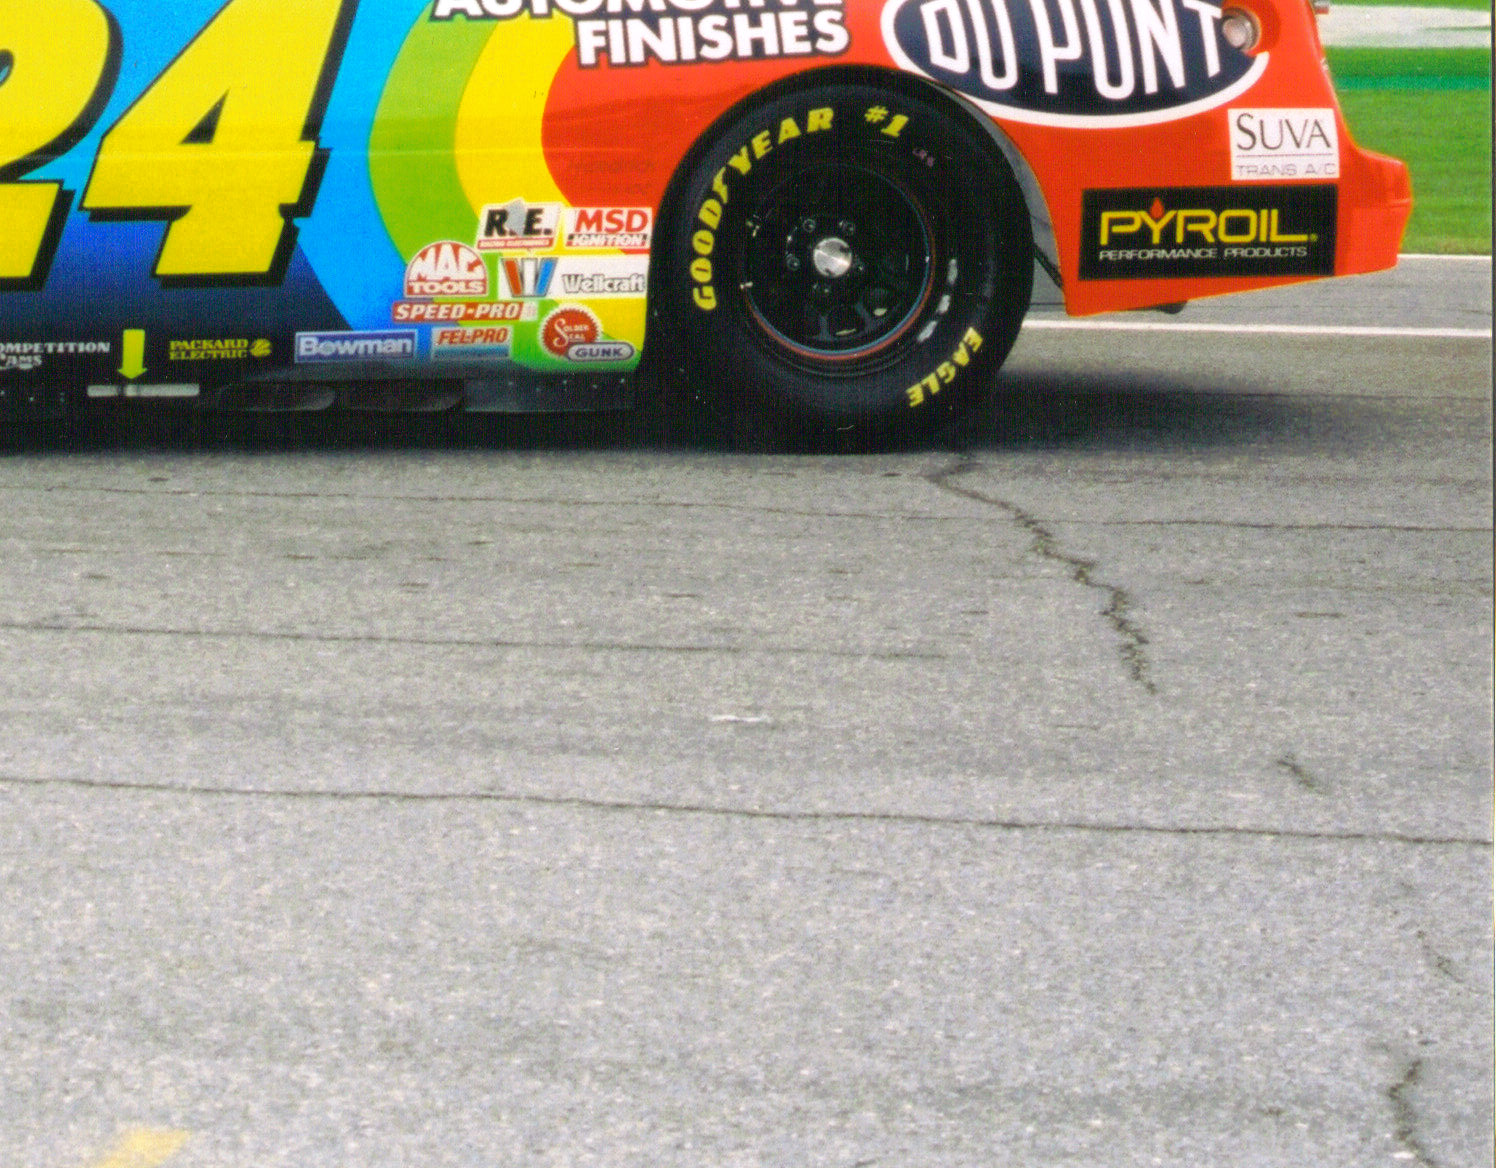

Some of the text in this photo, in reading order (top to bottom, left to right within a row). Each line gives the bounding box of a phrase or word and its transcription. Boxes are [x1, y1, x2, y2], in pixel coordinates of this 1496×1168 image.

[577, 12, 849, 66] FINISHES
[1236, 113, 1332, 151] SUVA
[1236, 163, 1336, 176] TRANS A/C
[690, 104, 909, 311] GOODYEAR #1
[575, 209, 648, 233] MSD
[1100, 208, 1308, 245] PYROIL
[571, 234, 643, 247] IGNITION
[408, 243, 485, 280] MAC
[1099, 246, 1308, 261] PERFORMANCE PRODUCTS
[409, 281, 484, 294] TOOLS
[562, 273, 645, 293] Wellcraft
[169, 339, 249, 350] PACKARD
[169, 349, 248, 360] ELECTRIC
[299, 336, 413, 357] Bowman
[575, 347, 623, 357] GUNK
[906, 327, 984, 408] EAGLE
